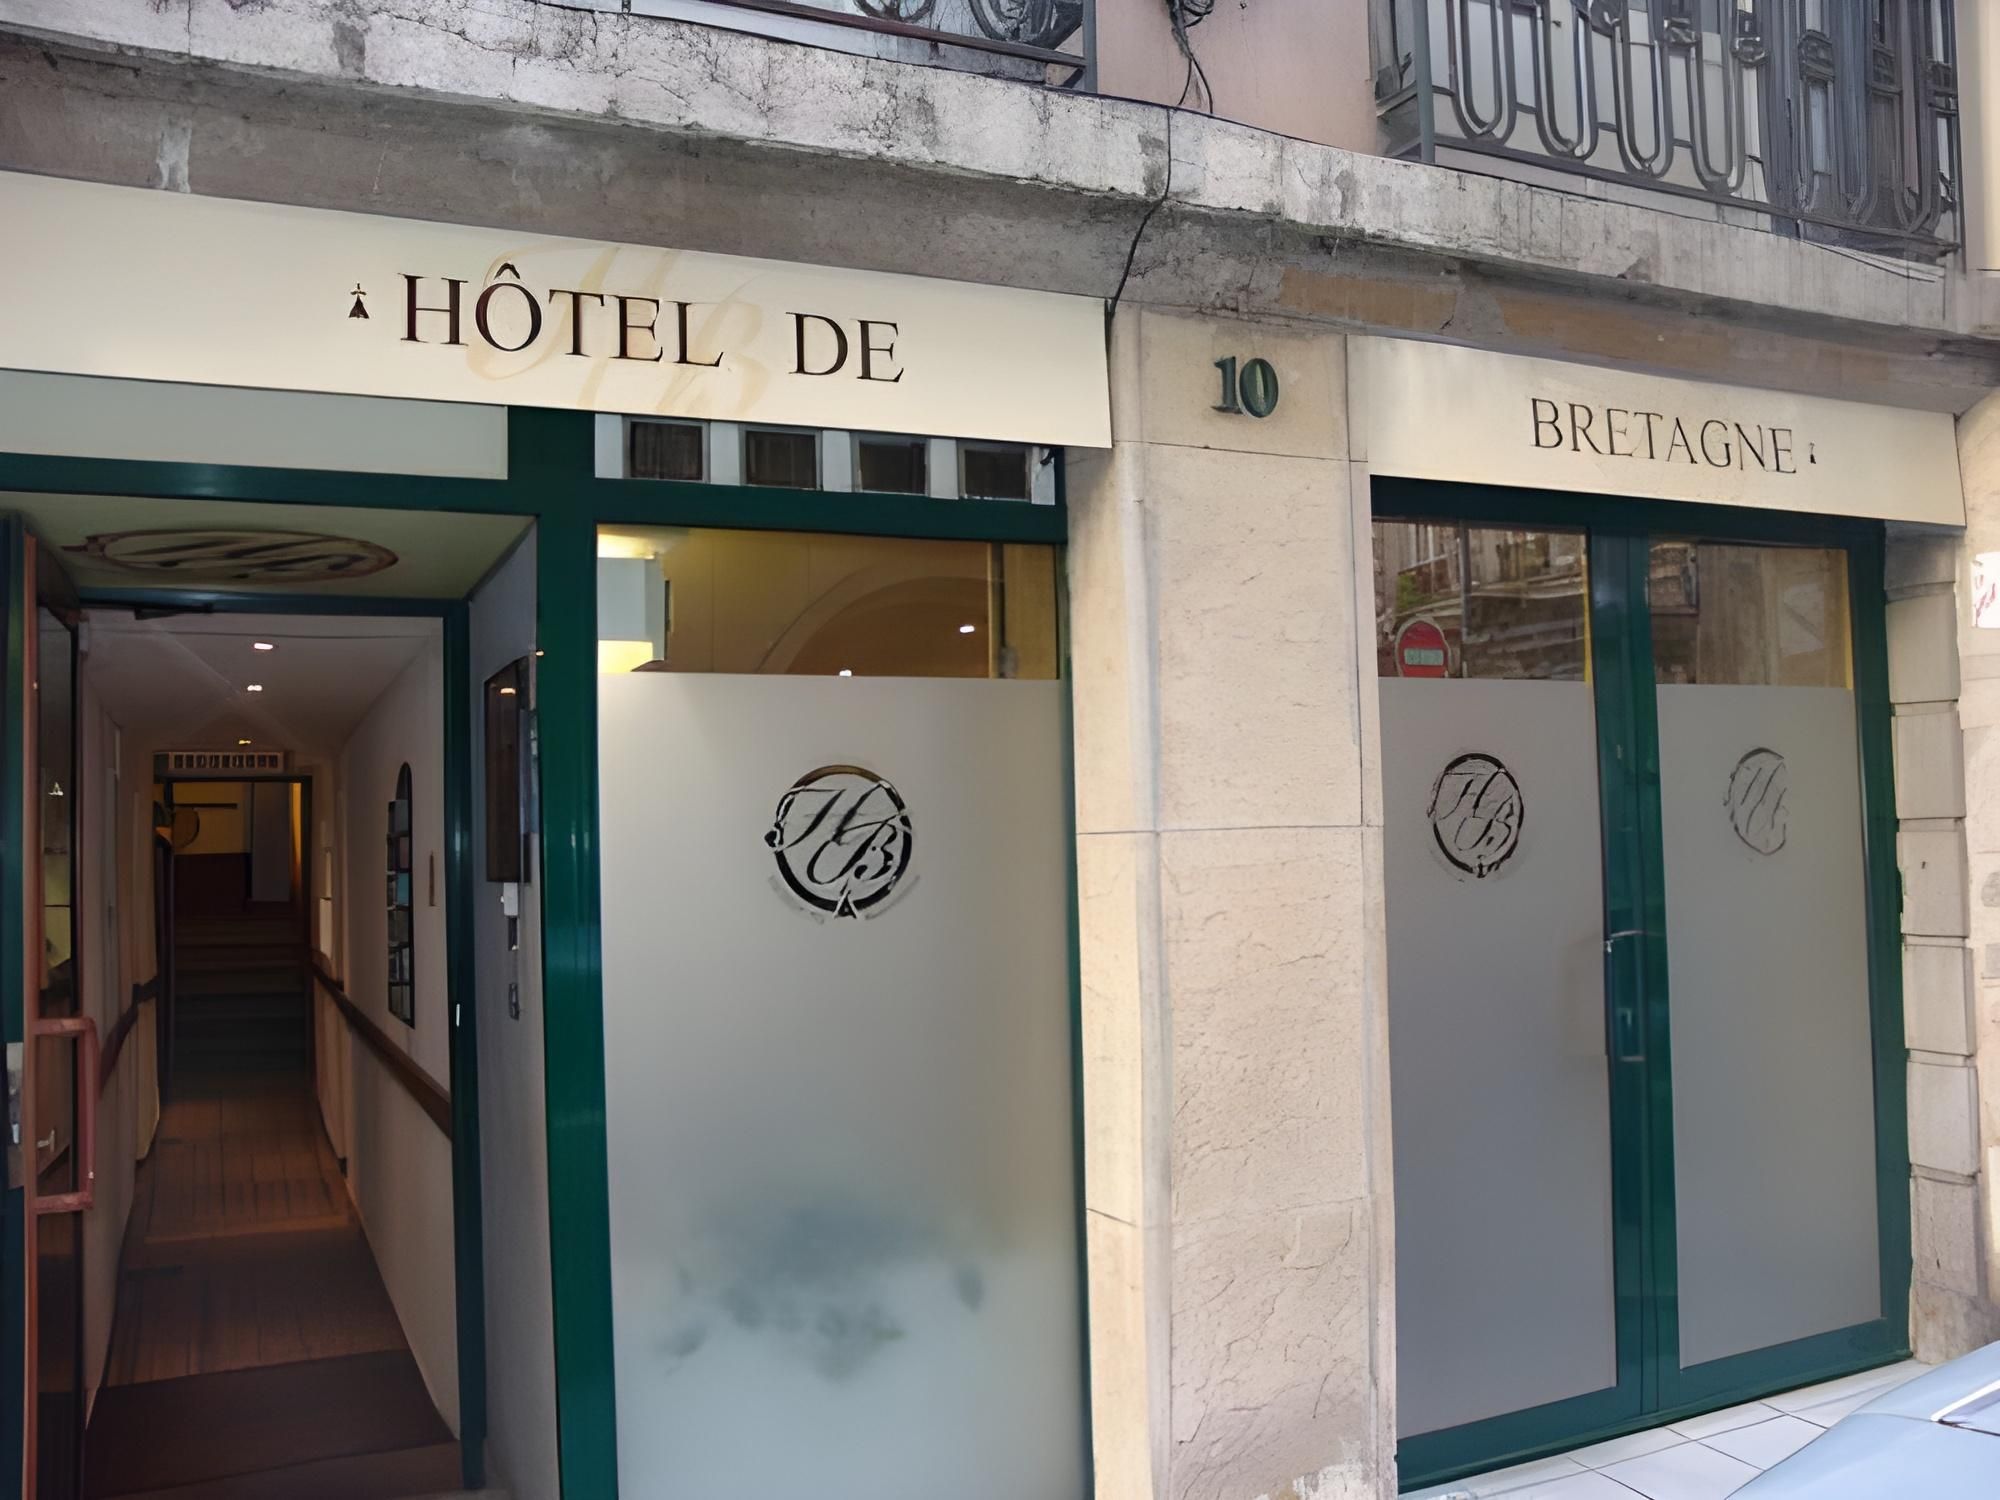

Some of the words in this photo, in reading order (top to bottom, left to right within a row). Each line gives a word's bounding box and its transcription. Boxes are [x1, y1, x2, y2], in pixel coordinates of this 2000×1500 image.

[397, 261, 725, 368] HÔTEL
[786, 311, 905, 384] DE
[1210, 355, 1279, 419] 10
[1530, 397, 1797, 474] BRETAGNE
